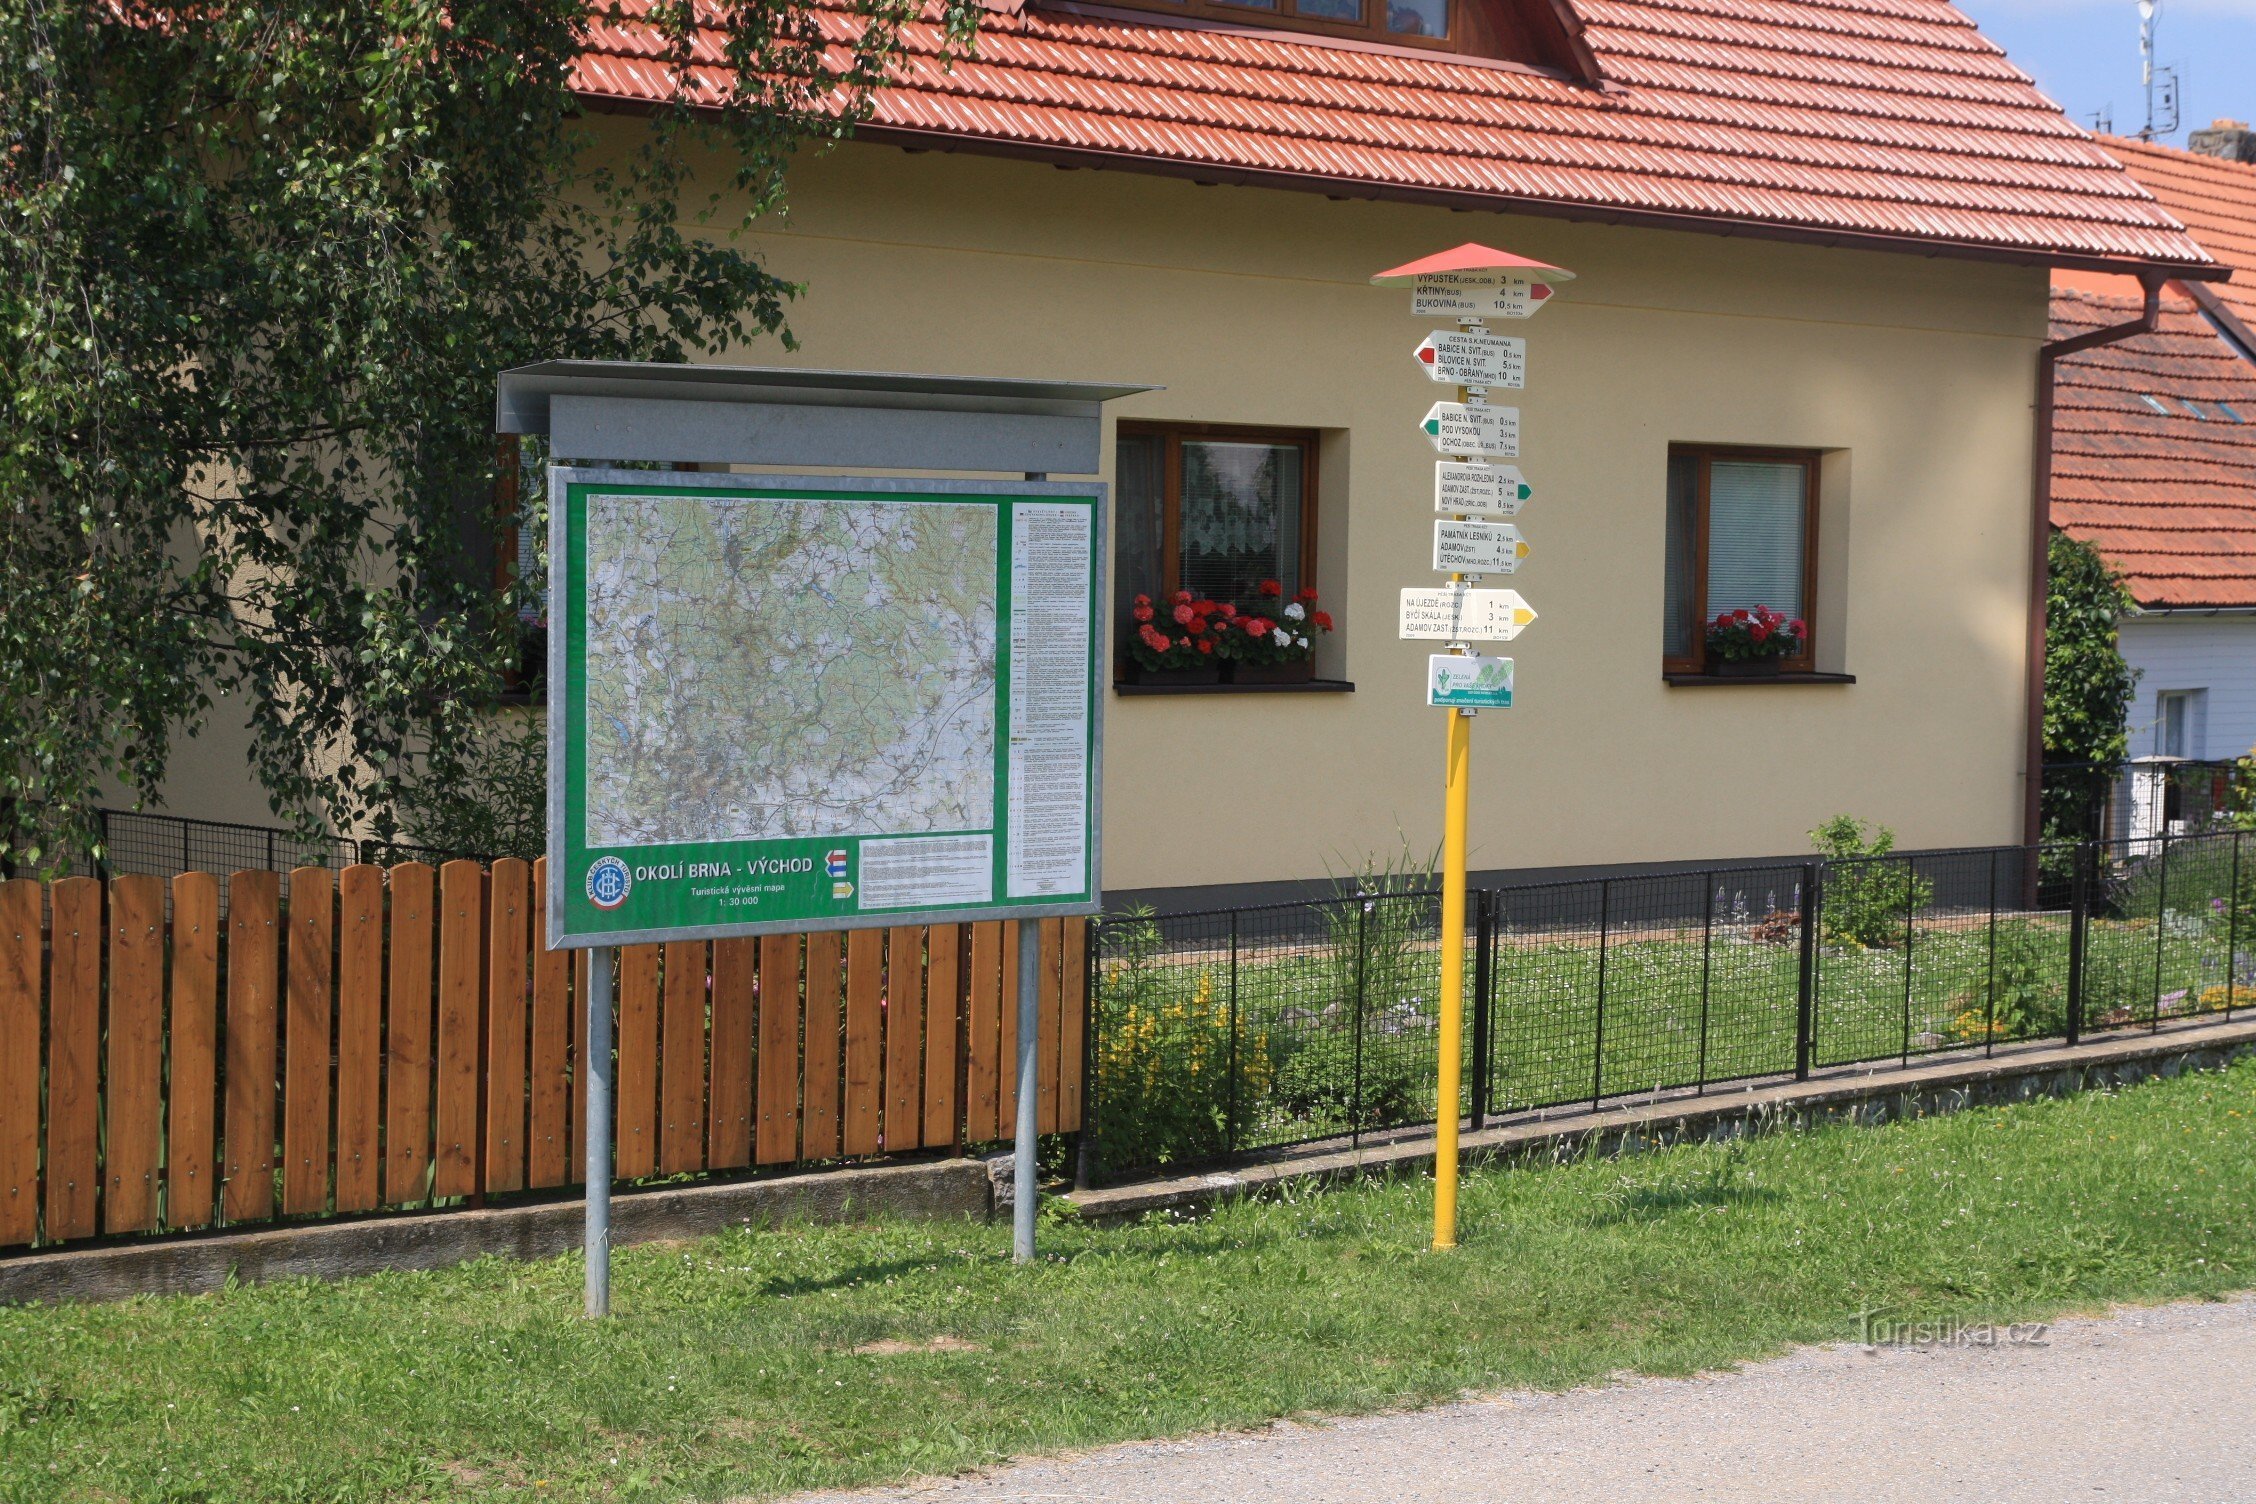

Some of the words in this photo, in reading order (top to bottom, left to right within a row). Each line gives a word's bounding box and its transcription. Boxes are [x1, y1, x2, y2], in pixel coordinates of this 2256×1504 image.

[1418, 273, 1459, 284] VÝPUSTEK
[1501, 276, 1507, 284] 3
[1500, 288, 1506, 297] 4
[1416, 299, 1458, 308] BUKOVINA
[1457, 302, 1476, 310] (BUS)
[1449, 336, 1468, 344] CESTA
[1438, 344, 1460, 353] BABICE
[1482, 350, 1495, 358] (BUS)
[1502, 361, 1512, 370] 5,5
[1438, 366, 1455, 376] BRNO
[1498, 372, 1507, 380] 10
[1442, 412, 1462, 422] BABICE
[1442, 425, 1454, 435] POD
[1455, 426, 1481, 436] VYSOKOU
[1442, 437, 1461, 447] OCHOZ
[1498, 488, 1503, 496] 5
[1441, 529, 1469, 540] PAMÁTNÍK
[1440, 543, 1464, 552] ADAMOV
[1407, 599, 1414, 607] NA
[1489, 601, 1493, 609] 1
[1489, 613, 1494, 621] 3
[1406, 624, 1433, 632] ADAMOV
[1484, 625, 1494, 633] 11
[635, 861, 684, 881] OKOLÍ
[688, 862, 731, 878] BRNA
[747, 856, 813, 875] VÝCHOD
[691, 886, 730, 896] Turistická
[732, 884, 762, 894] vývěsní
[764, 884, 785, 893] mapa
[719, 898, 727, 907] 1:
[729, 897, 740, 906] 30
[742, 896, 759, 905] 000
